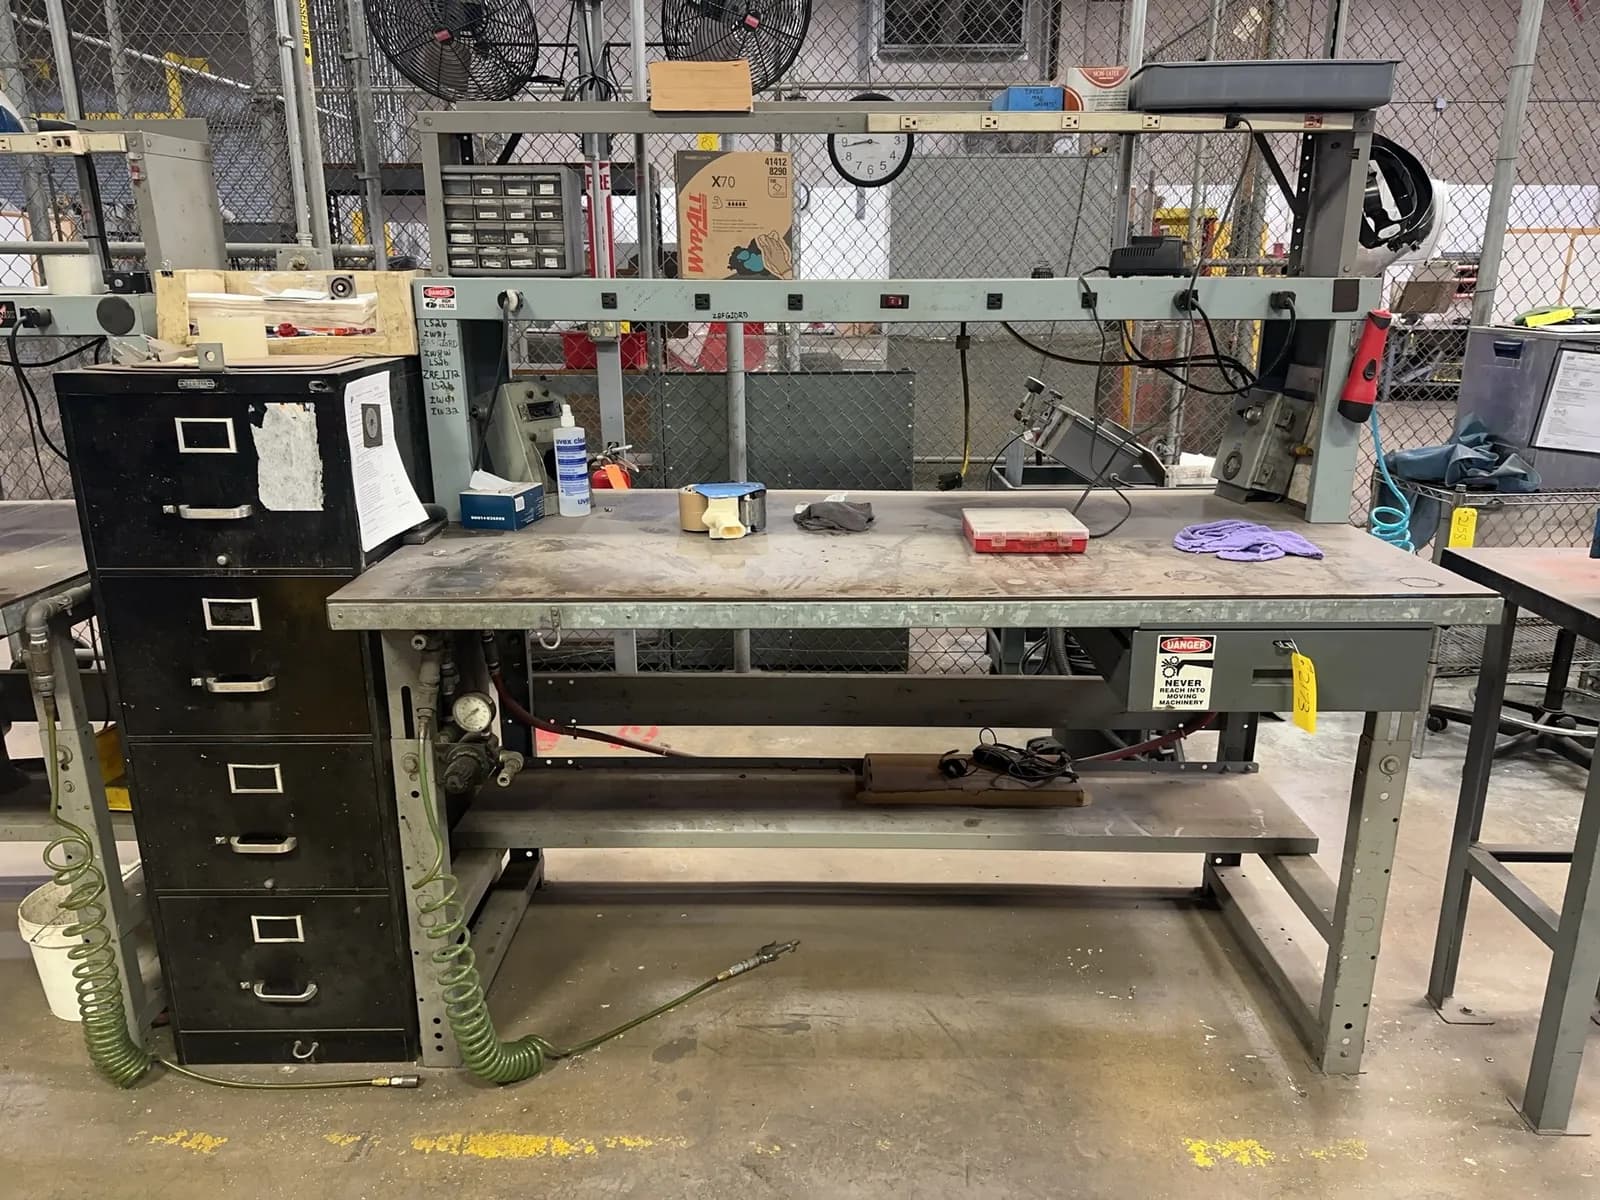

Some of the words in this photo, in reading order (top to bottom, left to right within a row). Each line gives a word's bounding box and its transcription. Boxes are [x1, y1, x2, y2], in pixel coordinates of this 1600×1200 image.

[841, 136, 848, 147] 9
[894, 135, 901, 145] 3
[845, 151, 852, 161] 8
[889, 150, 896, 160] 4
[765, 157, 787, 166] 41412
[856, 161, 862, 170] 7
[879, 160, 887, 170] 5
[769, 167, 787, 176] 8290
[867, 164, 874, 175] 6
[712, 175, 736, 188] X70
[1166, 640, 1208, 650] DANGER
[1165, 679, 1202, 687] NEVER
